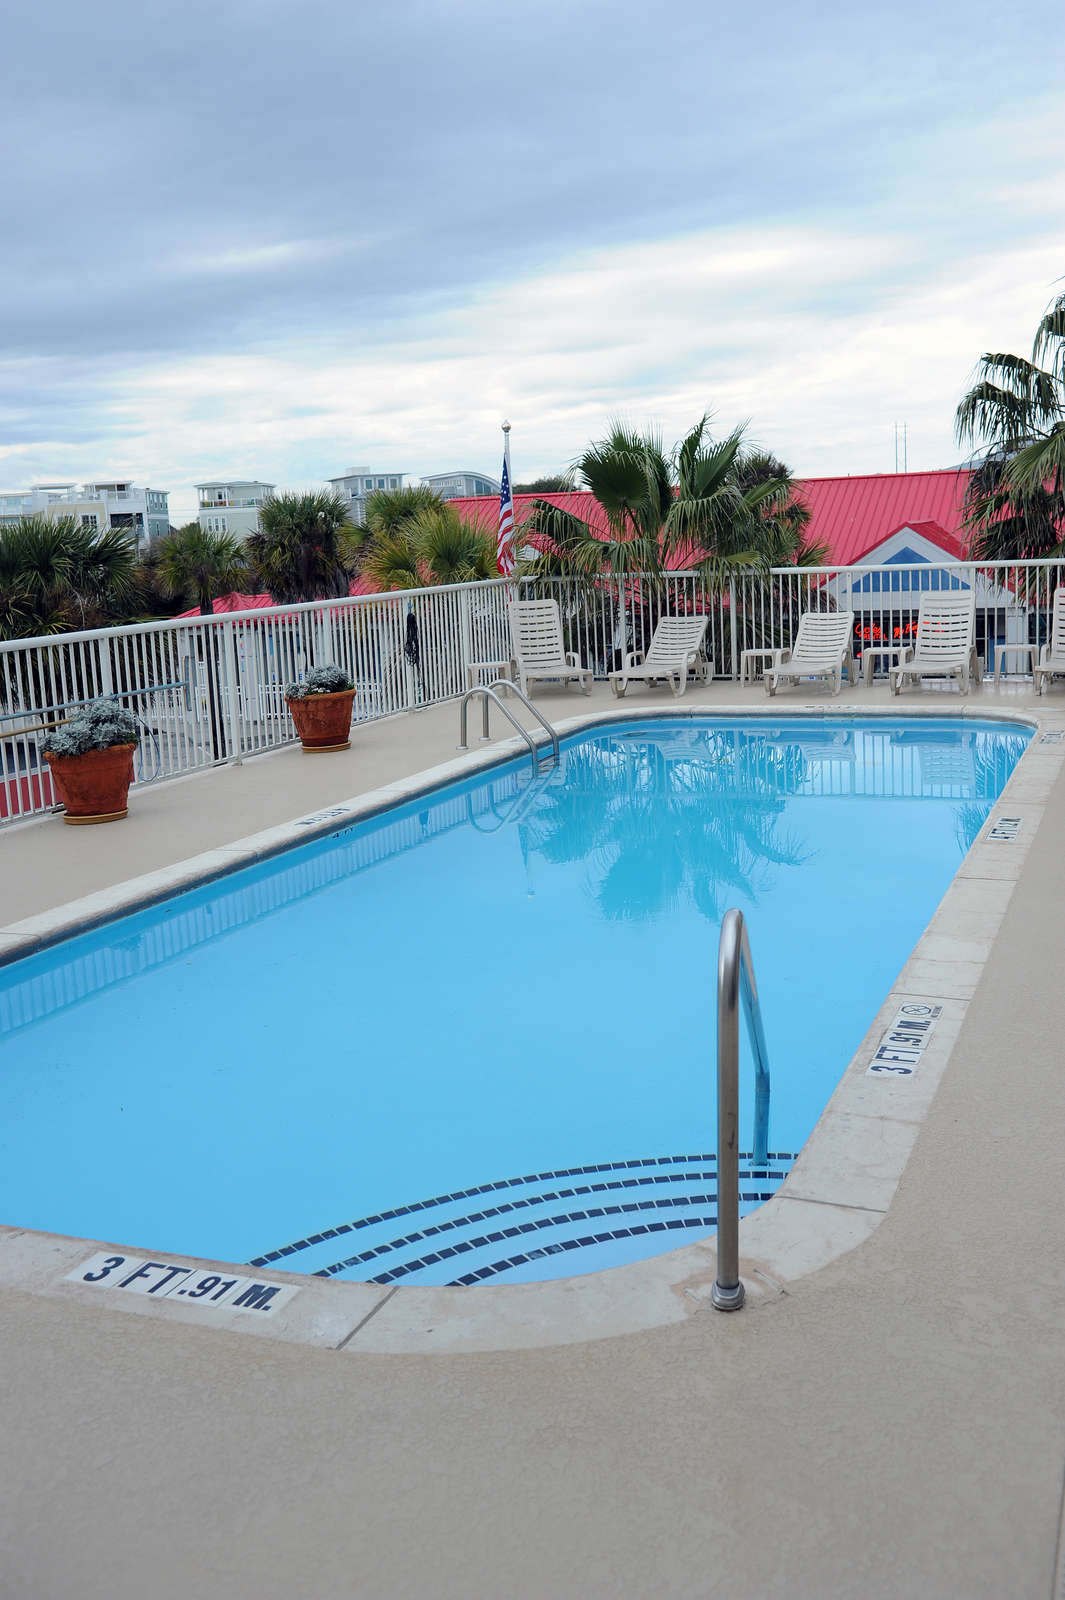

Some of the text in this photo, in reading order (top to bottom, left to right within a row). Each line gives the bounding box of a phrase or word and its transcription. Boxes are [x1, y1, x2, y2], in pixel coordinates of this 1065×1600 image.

[875, 1046, 920, 1063] FT
[870, 1065, 912, 1075] 3
[83, 1256, 125, 1282] 3
[118, 1262, 192, 1294] FT
